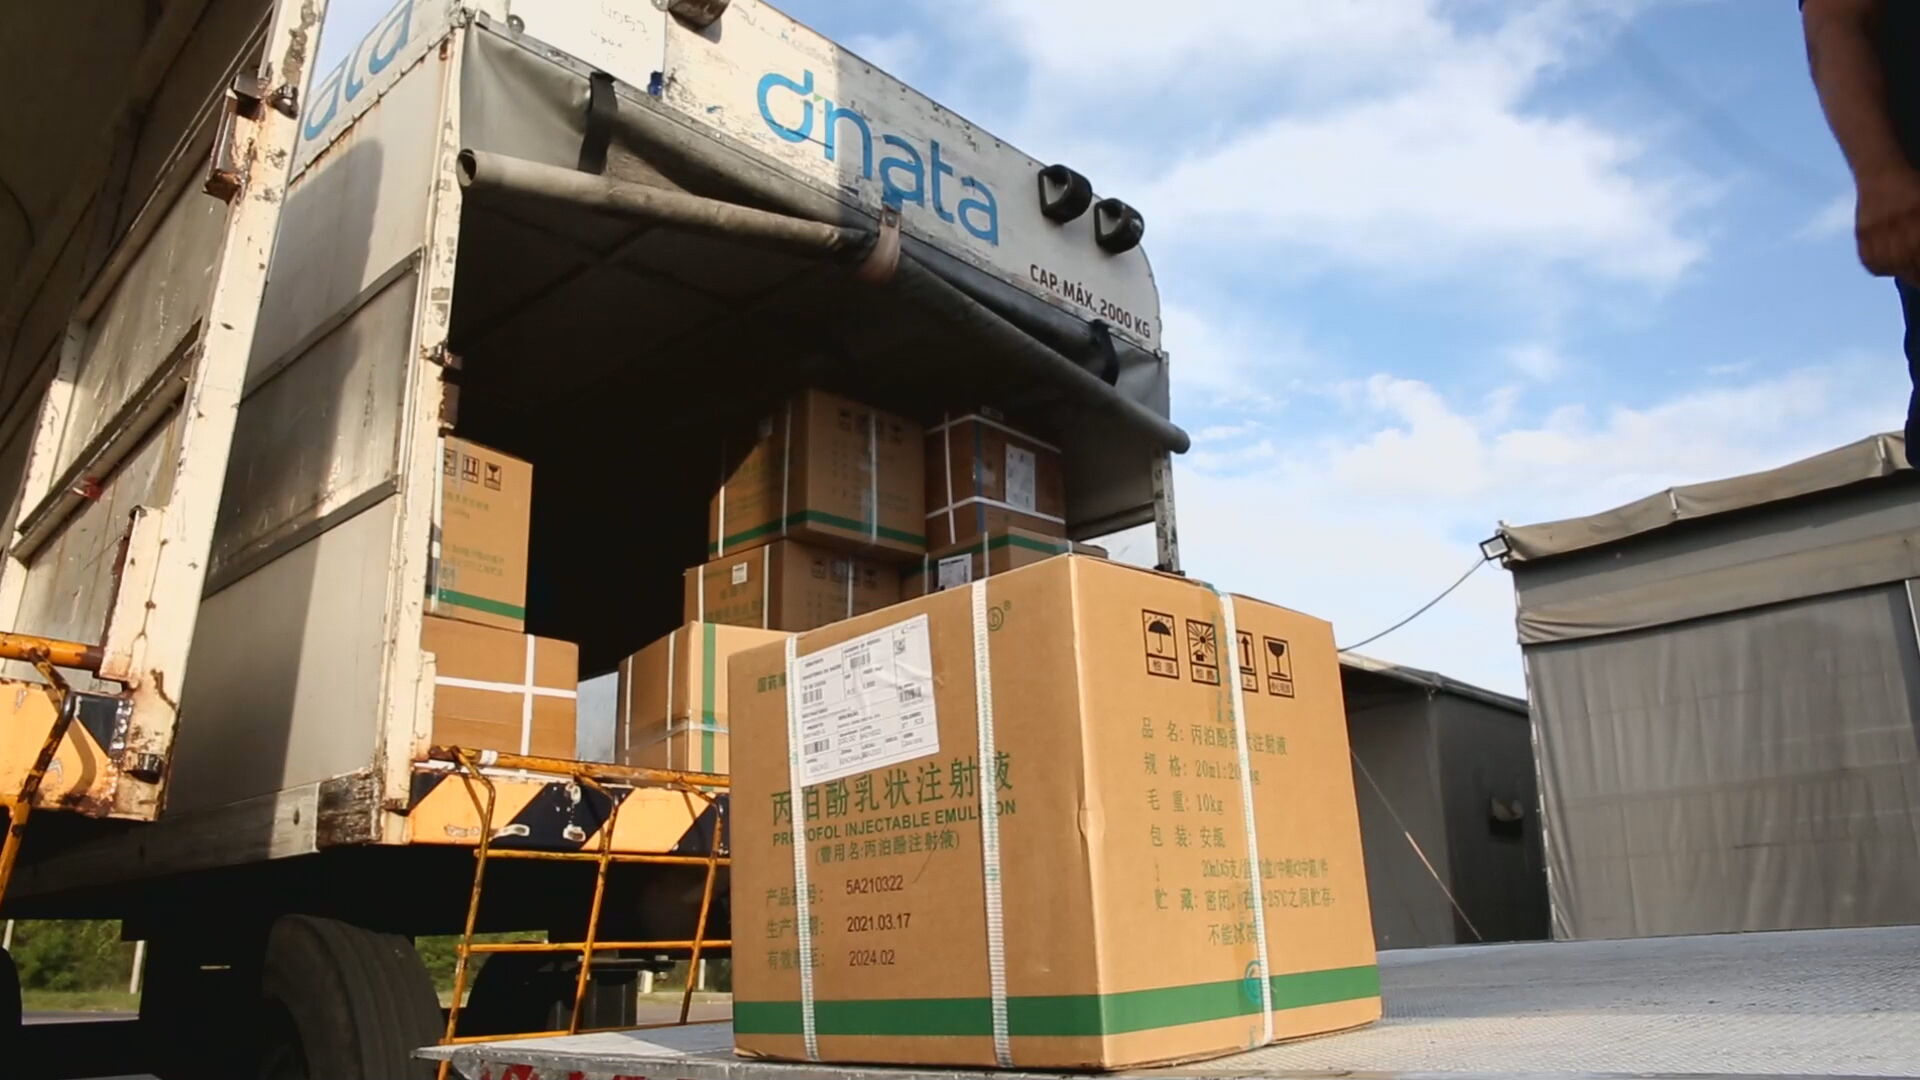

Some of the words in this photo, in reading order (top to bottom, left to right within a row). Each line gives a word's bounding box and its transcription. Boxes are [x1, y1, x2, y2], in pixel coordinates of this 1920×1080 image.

[757, 70, 999, 246] dnata
[1030, 263, 1060, 293] CAP.
[1063, 280, 1097, 313] MÁX.
[1099, 298, 1132, 329] 2000
[1134, 318, 1151, 339] KG
[772, 822, 841, 847] PROFOL
[845, 810, 931, 837] INJECTABLE
[936, 799, 1016, 826] EMULON
[846, 875, 904, 895] 5A210322
[847, 912, 912, 933] 2021.03.17
[849, 949, 896, 967] 2024.02
